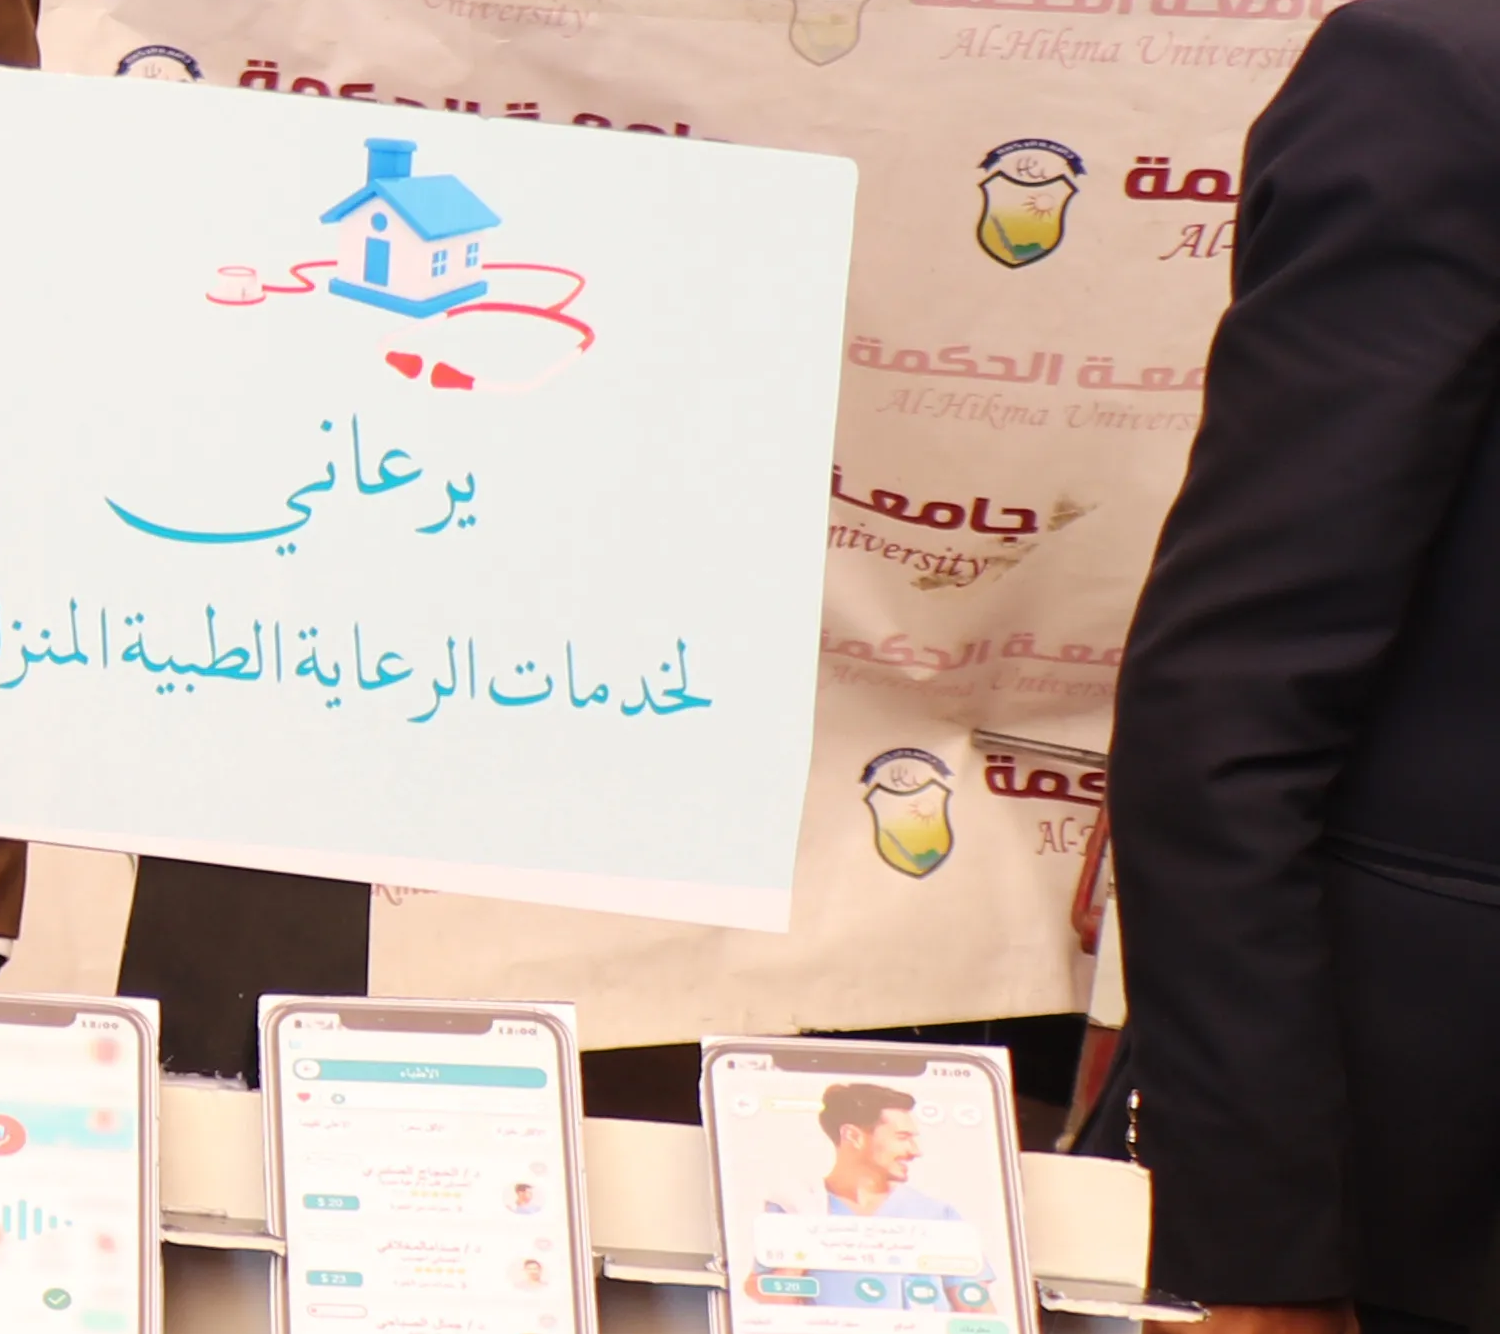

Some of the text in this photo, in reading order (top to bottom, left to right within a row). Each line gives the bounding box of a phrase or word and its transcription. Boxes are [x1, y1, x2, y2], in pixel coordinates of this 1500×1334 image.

[103, 412, 477, 556] يرعاني
[827, 520, 988, 588] niversity
[120, 604, 283, 696] الطبية
[294, 621, 476, 723] الرعاية
[487, 635, 712, 715] لخدمات
